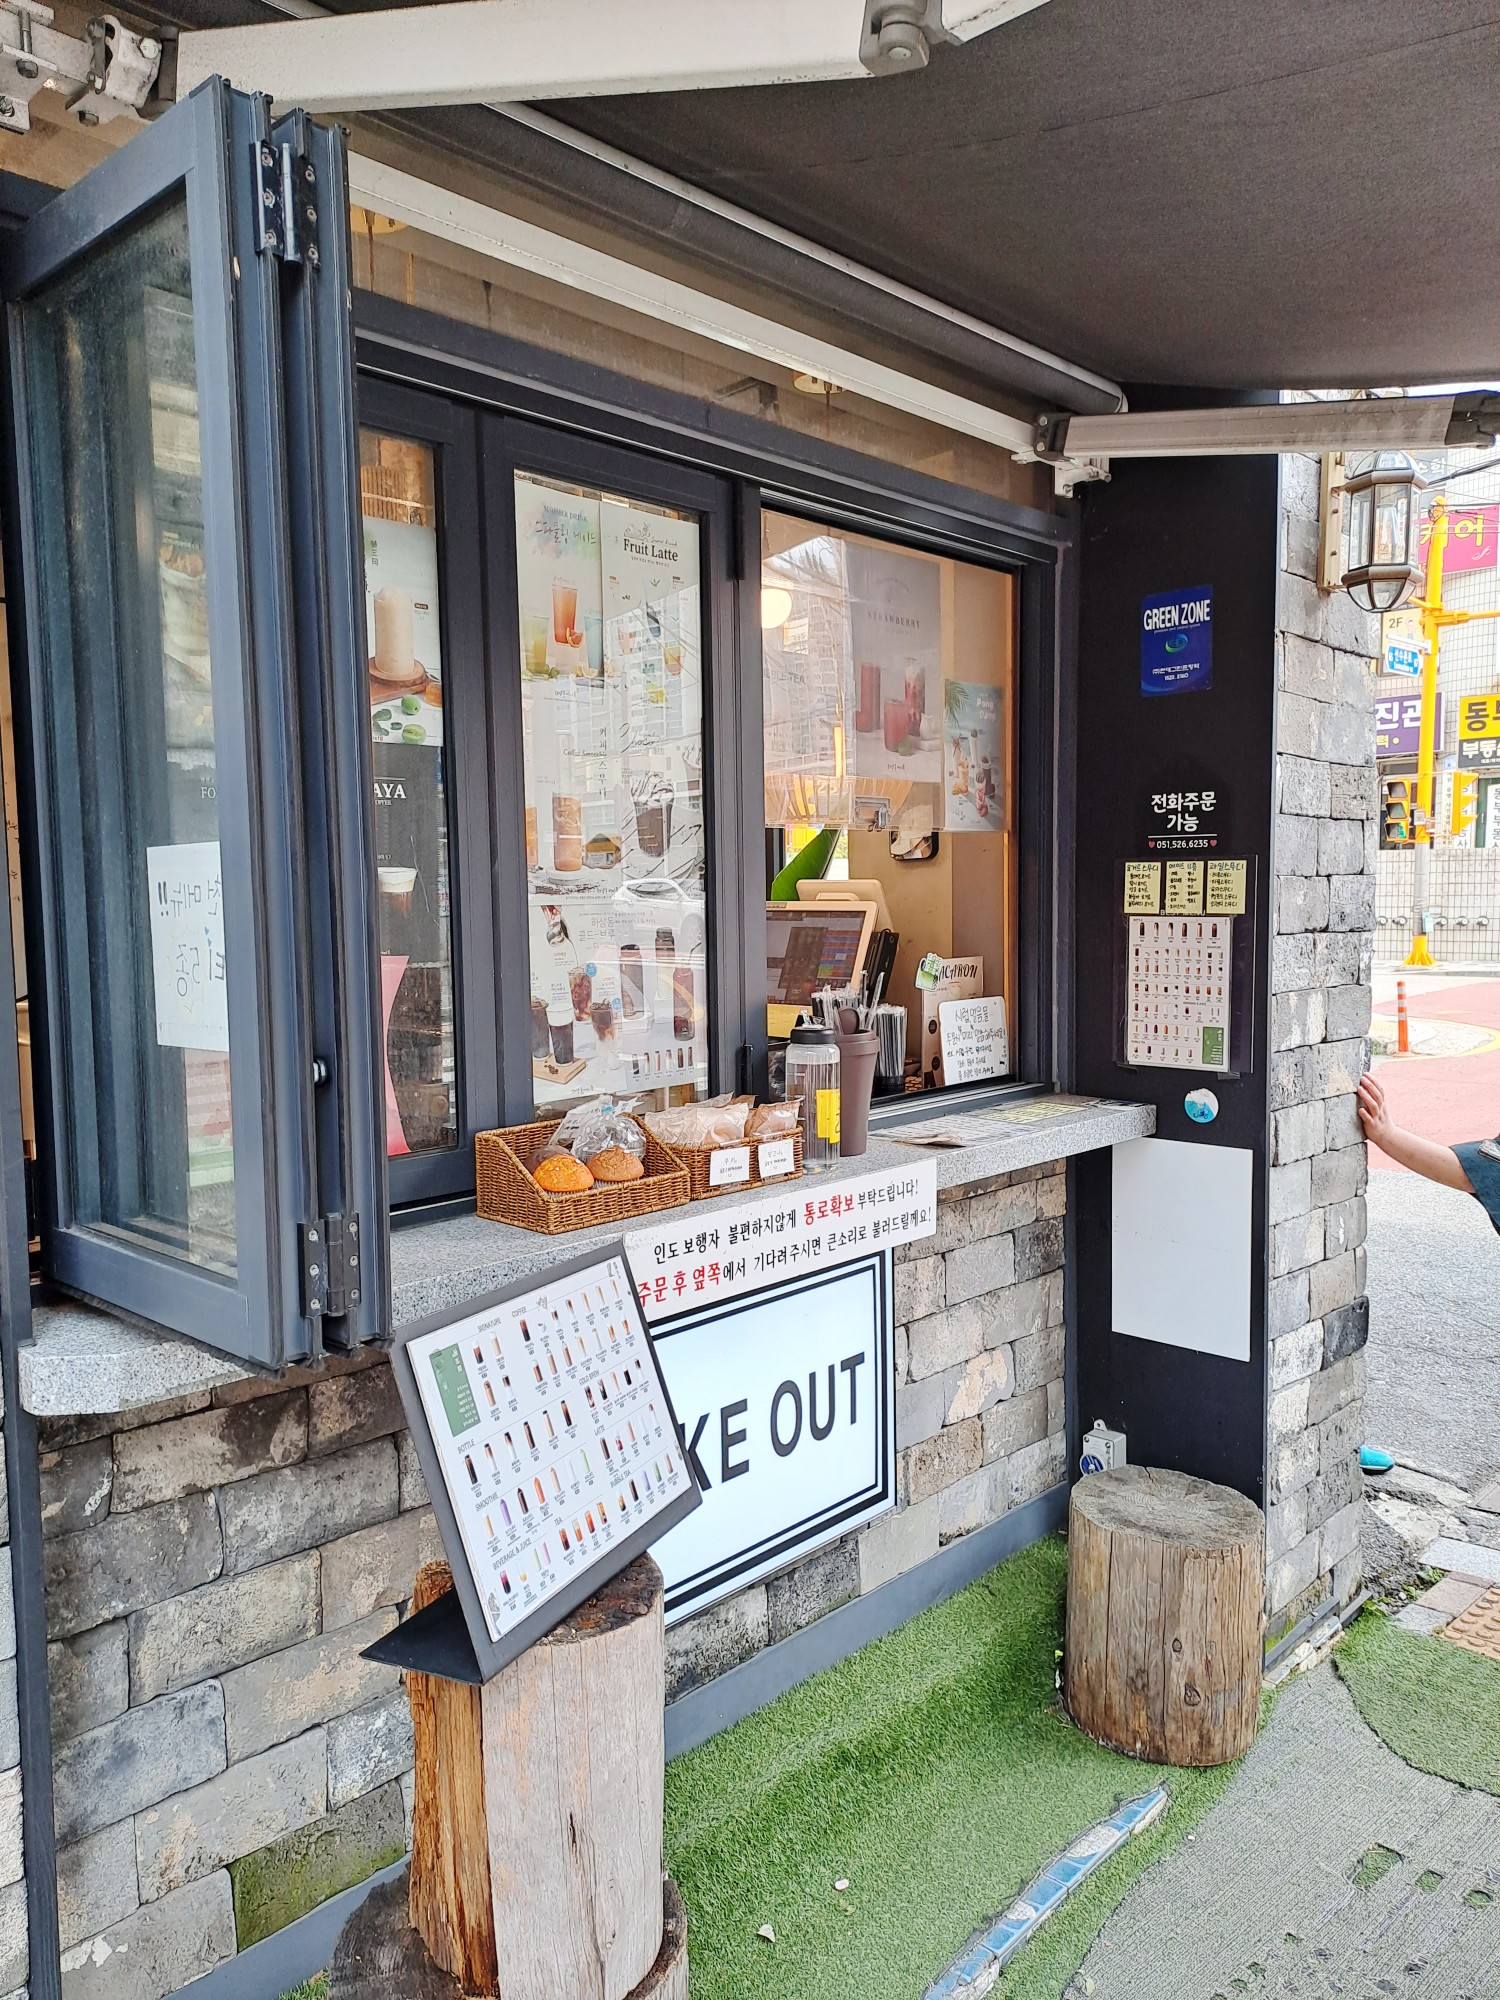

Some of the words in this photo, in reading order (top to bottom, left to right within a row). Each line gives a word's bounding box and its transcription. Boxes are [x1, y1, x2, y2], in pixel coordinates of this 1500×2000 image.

[543, 505, 569, 519] SUMMER
[623, 538, 648, 557] Fruit
[651, 544, 678, 562] Latte
[867, 610, 920, 628] STRAWBERRY
[1143, 604, 1179, 631] GREEN
[1180, 599, 1211, 624] ZONE
[1388, 617, 1403, 629] 2F
[1151, 791, 1217, 813] 전화주문
[1167, 813, 1199, 832] 가능
[939, 964, 978, 982] ACARON
[804, 1194, 854, 1226] 통로확보
[857, 1178, 919, 1208] 부탁드립니다!
[679, 1398, 750, 1492] KE
[770, 1351, 865, 1457] OUT
[457, 1438, 476, 1454] BOTTLE
[475, 1492, 499, 1512] SMOOTHIE
